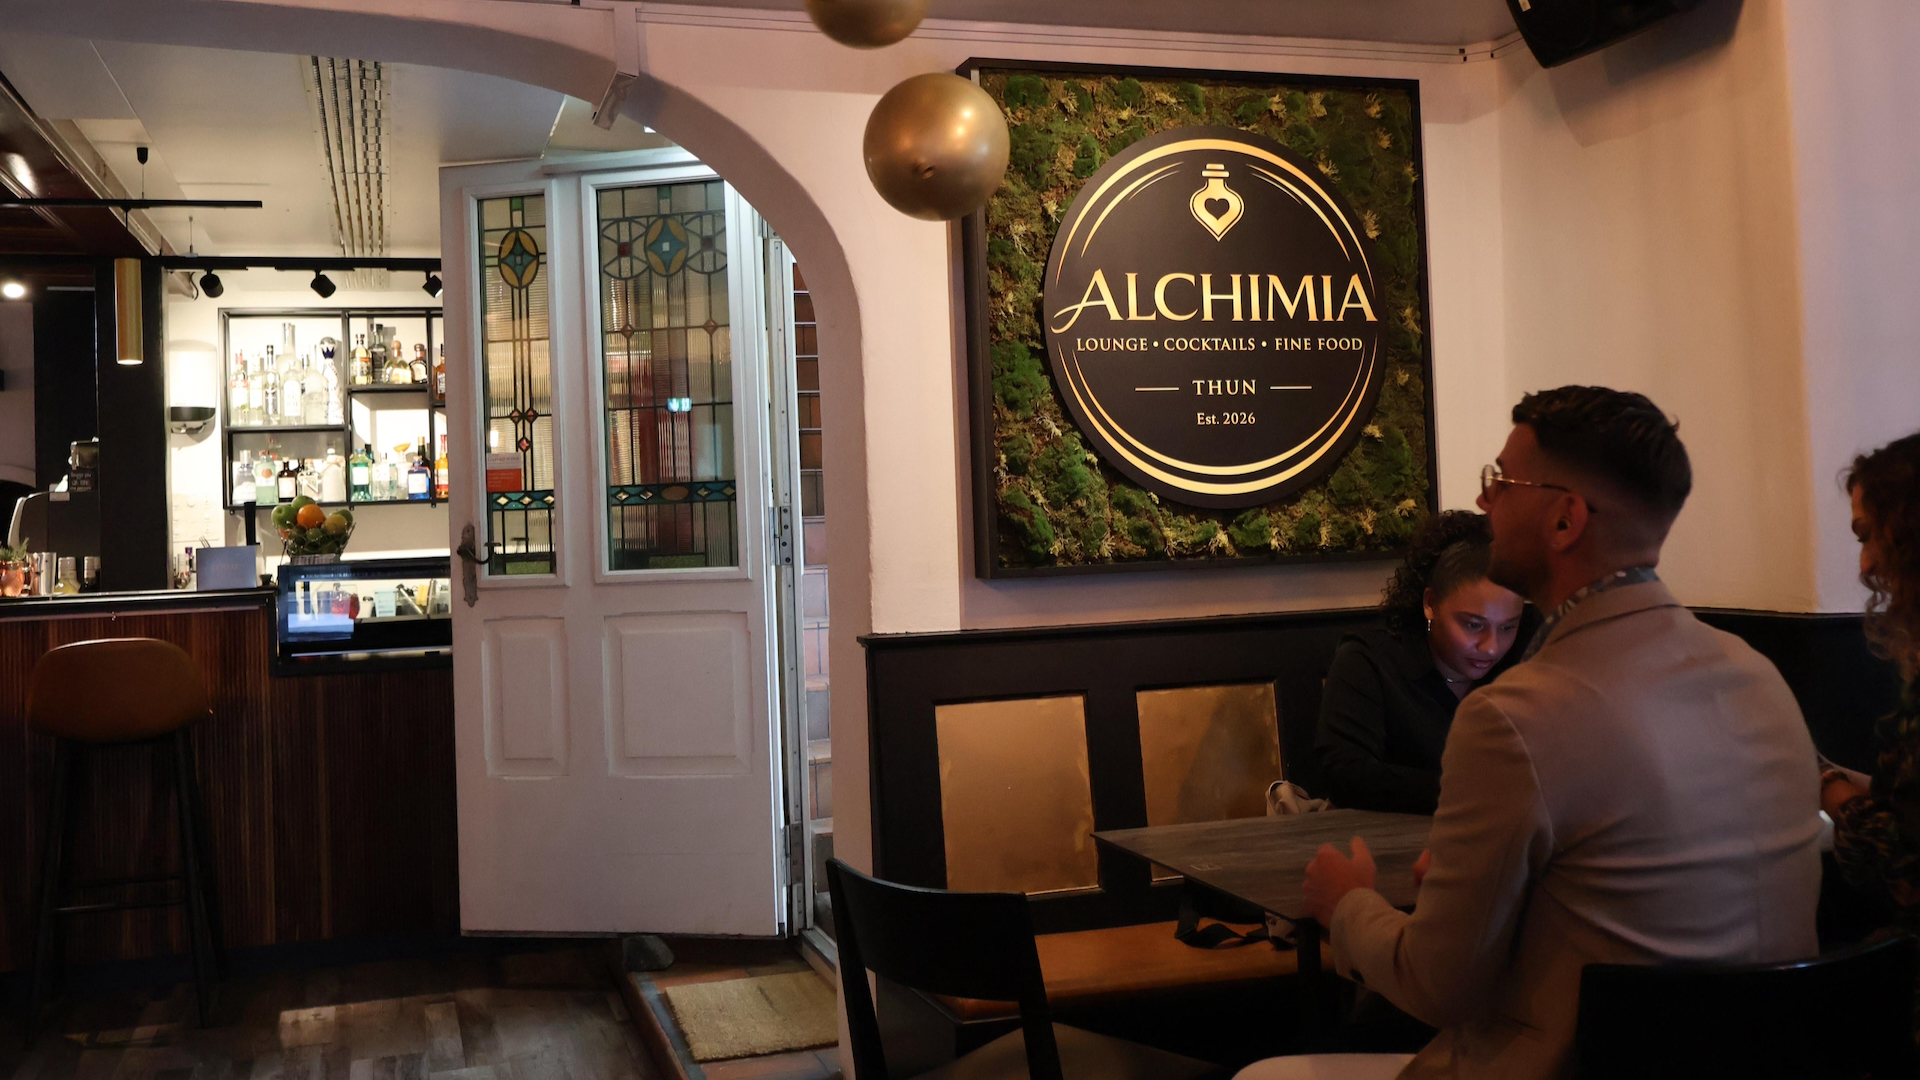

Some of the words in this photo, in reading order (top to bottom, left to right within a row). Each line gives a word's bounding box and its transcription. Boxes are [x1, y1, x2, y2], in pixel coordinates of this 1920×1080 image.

[1051, 268, 1378, 333] ALCHIMIA
[1076, 337, 1149, 352] LOUNGE
[1163, 337, 1256, 352] COCKTAILS
[1274, 337, 1312, 351] FINE
[1317, 337, 1363, 352] FOOD
[1191, 379, 1256, 396] THUN
[1196, 412, 1220, 426] Est.
[1222, 411, 1256, 425] 2026
